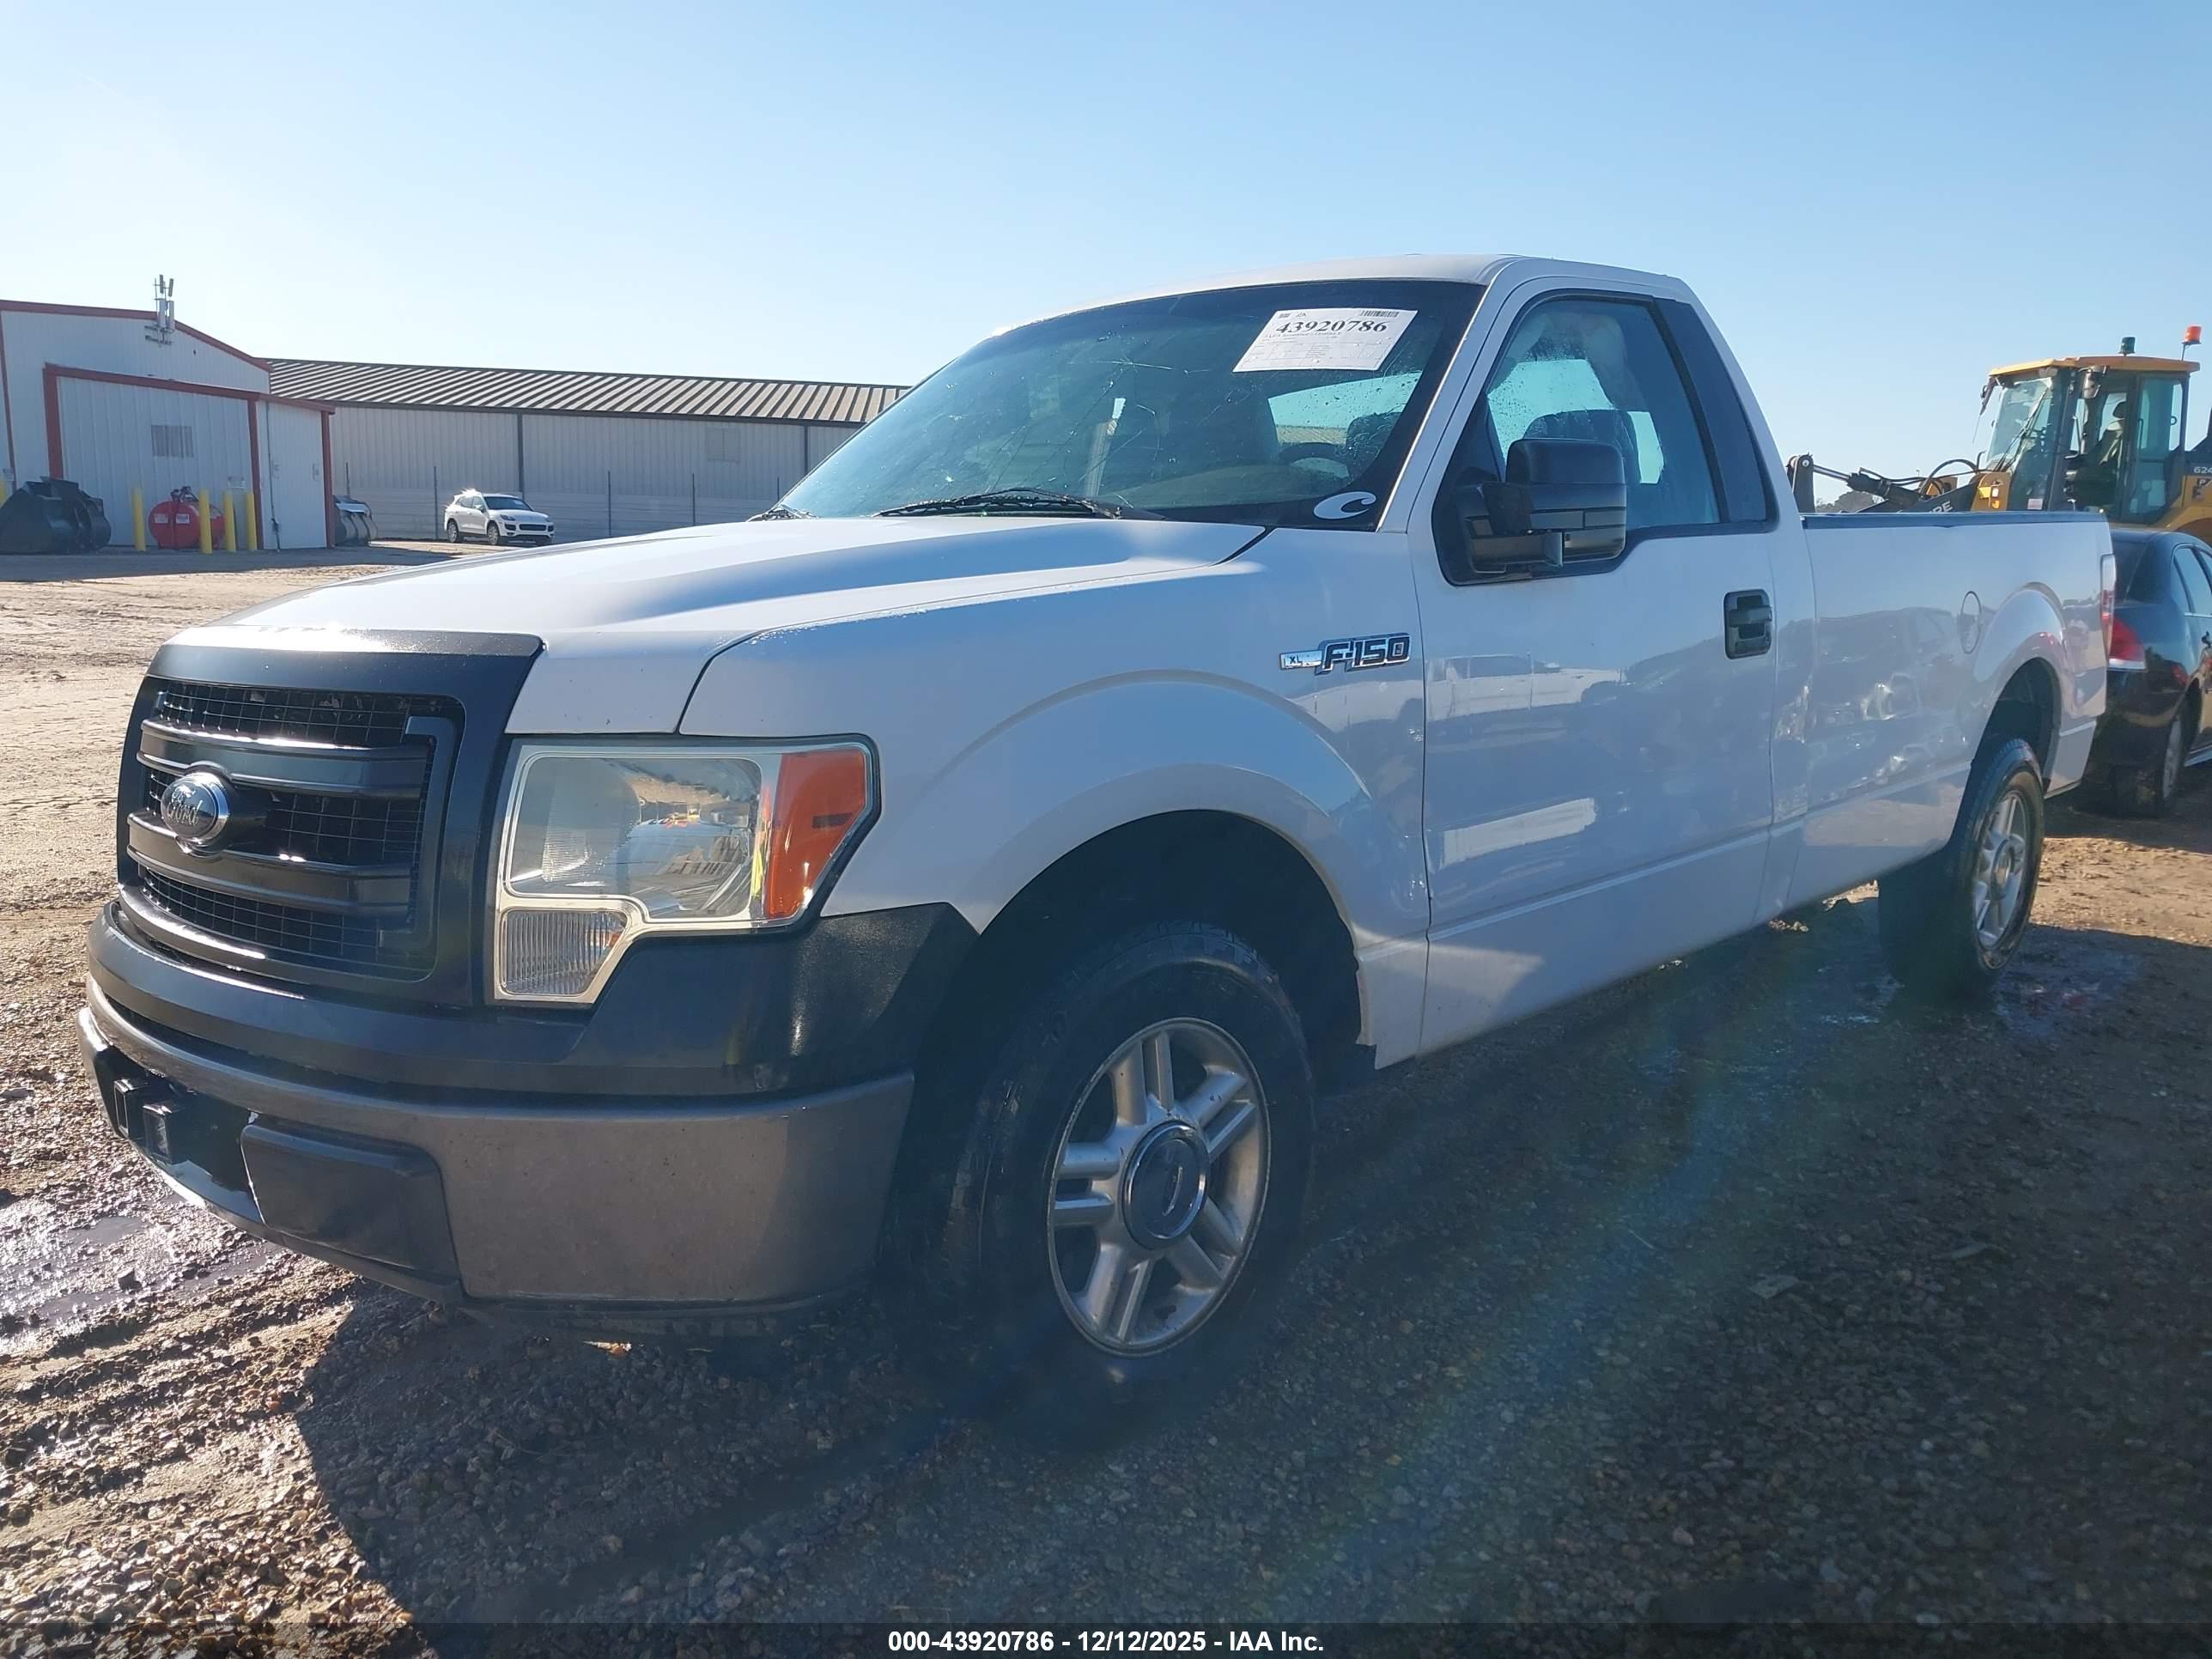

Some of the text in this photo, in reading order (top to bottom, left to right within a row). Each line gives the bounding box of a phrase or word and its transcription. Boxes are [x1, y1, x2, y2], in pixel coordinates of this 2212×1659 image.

[1275, 319, 1389, 334] 43920786
[1289, 635, 1411, 672] XL F-150
